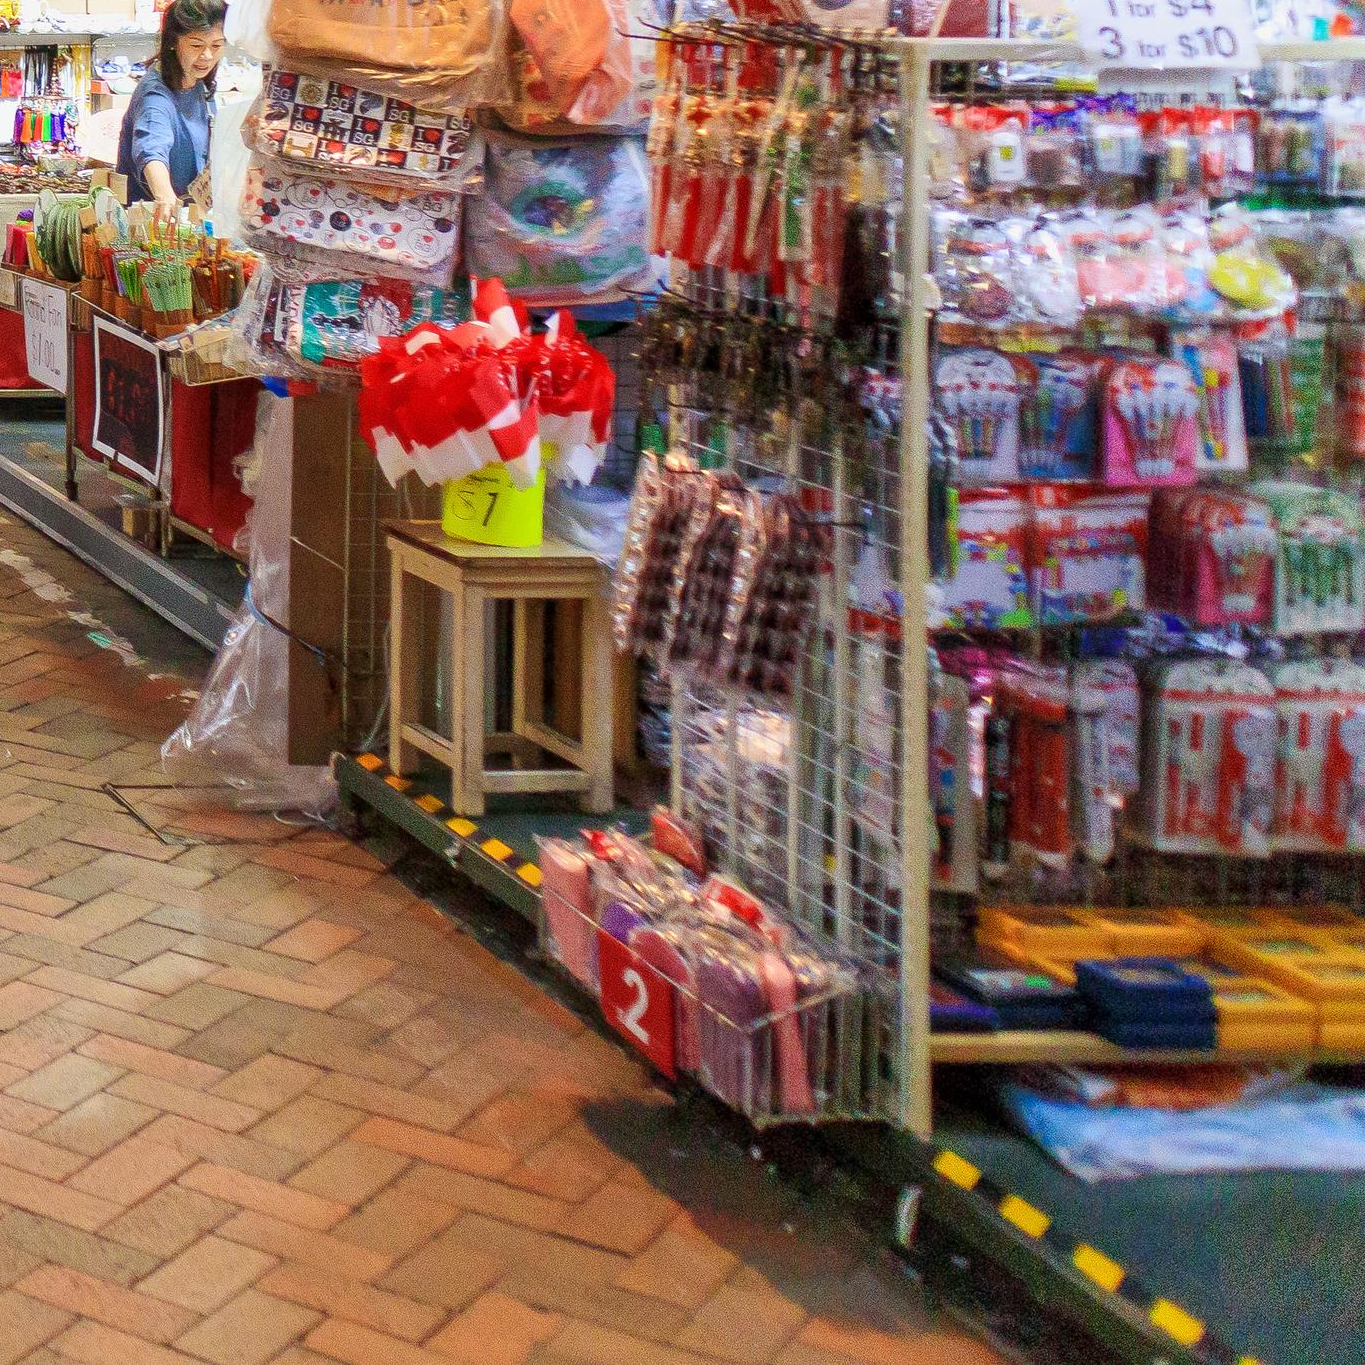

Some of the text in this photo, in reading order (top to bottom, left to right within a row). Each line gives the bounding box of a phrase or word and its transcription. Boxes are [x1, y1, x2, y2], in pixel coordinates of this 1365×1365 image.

[1099, 26, 1126, 59] 3
[1178, 25, 1238, 59] $10
[292, 119, 315, 133] SG
[615, 966, 650, 1045] 2
